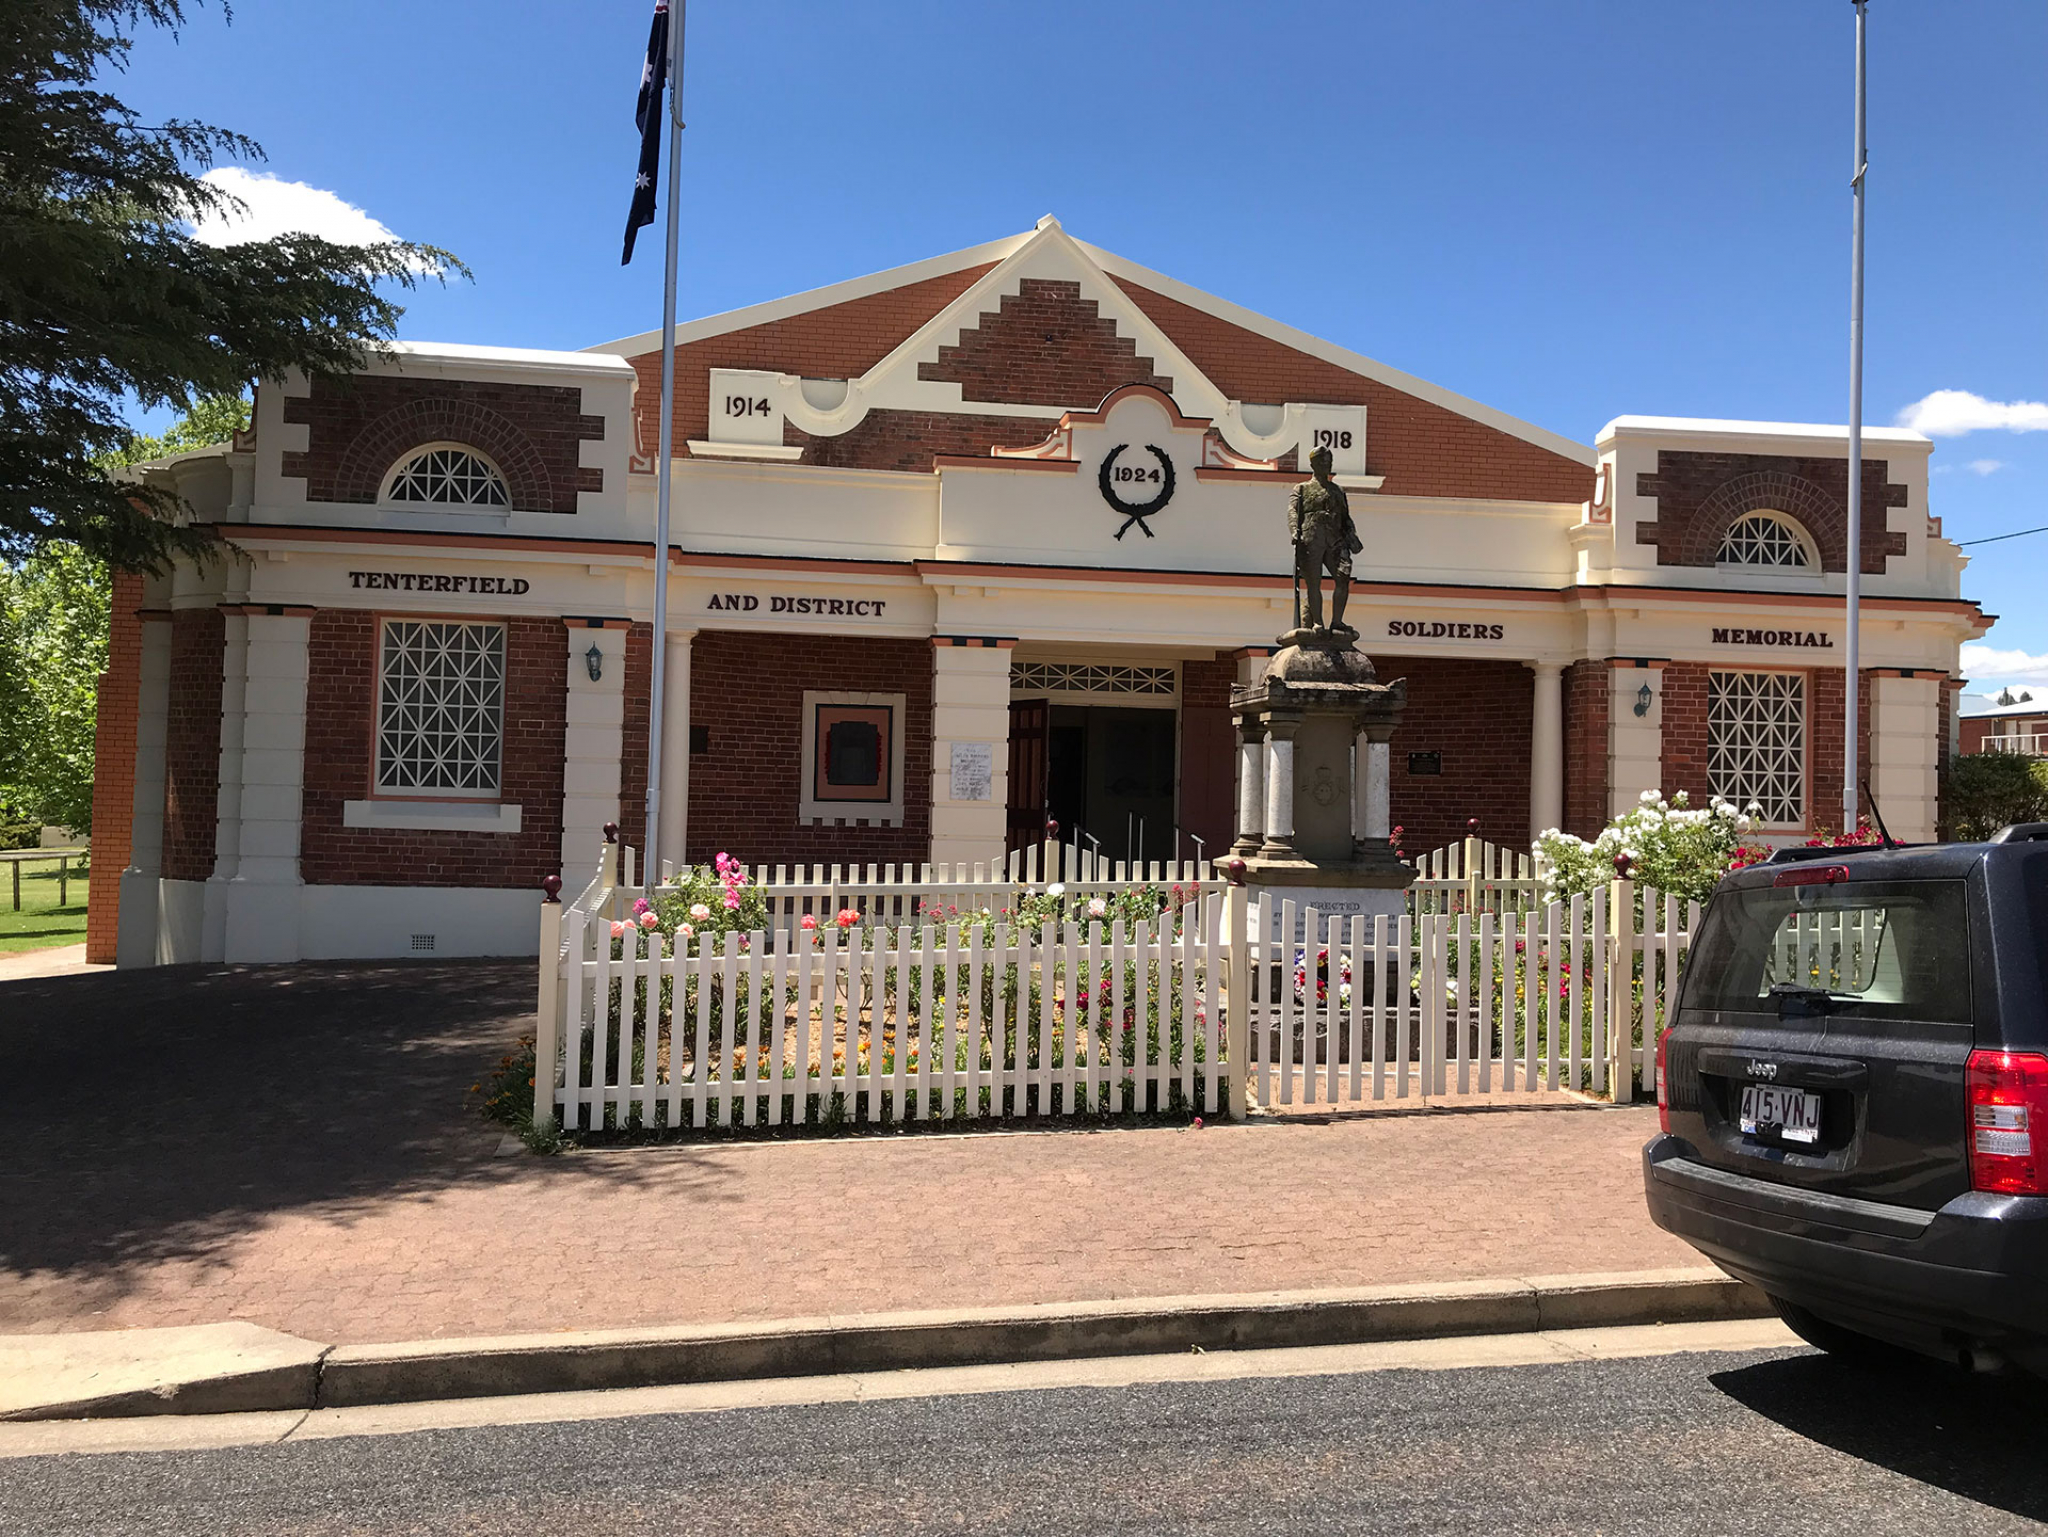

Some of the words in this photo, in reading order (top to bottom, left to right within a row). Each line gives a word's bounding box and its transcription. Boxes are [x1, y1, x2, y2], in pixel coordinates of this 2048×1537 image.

[726, 396, 771, 417] 1914
[1314, 430, 1352, 449] 1918
[1115, 467, 1160, 483] 1924
[349, 571, 530, 595] TENTERFIELD
[707, 594, 759, 611] AND
[770, 596, 886, 617] DISTRICT
[1388, 621, 1504, 640] SOLDIERS
[1712, 628, 1833, 648] MEMORIAL
[1310, 901, 1360, 911] ERECTED
[1747, 1059, 1777, 1081] Jeep
